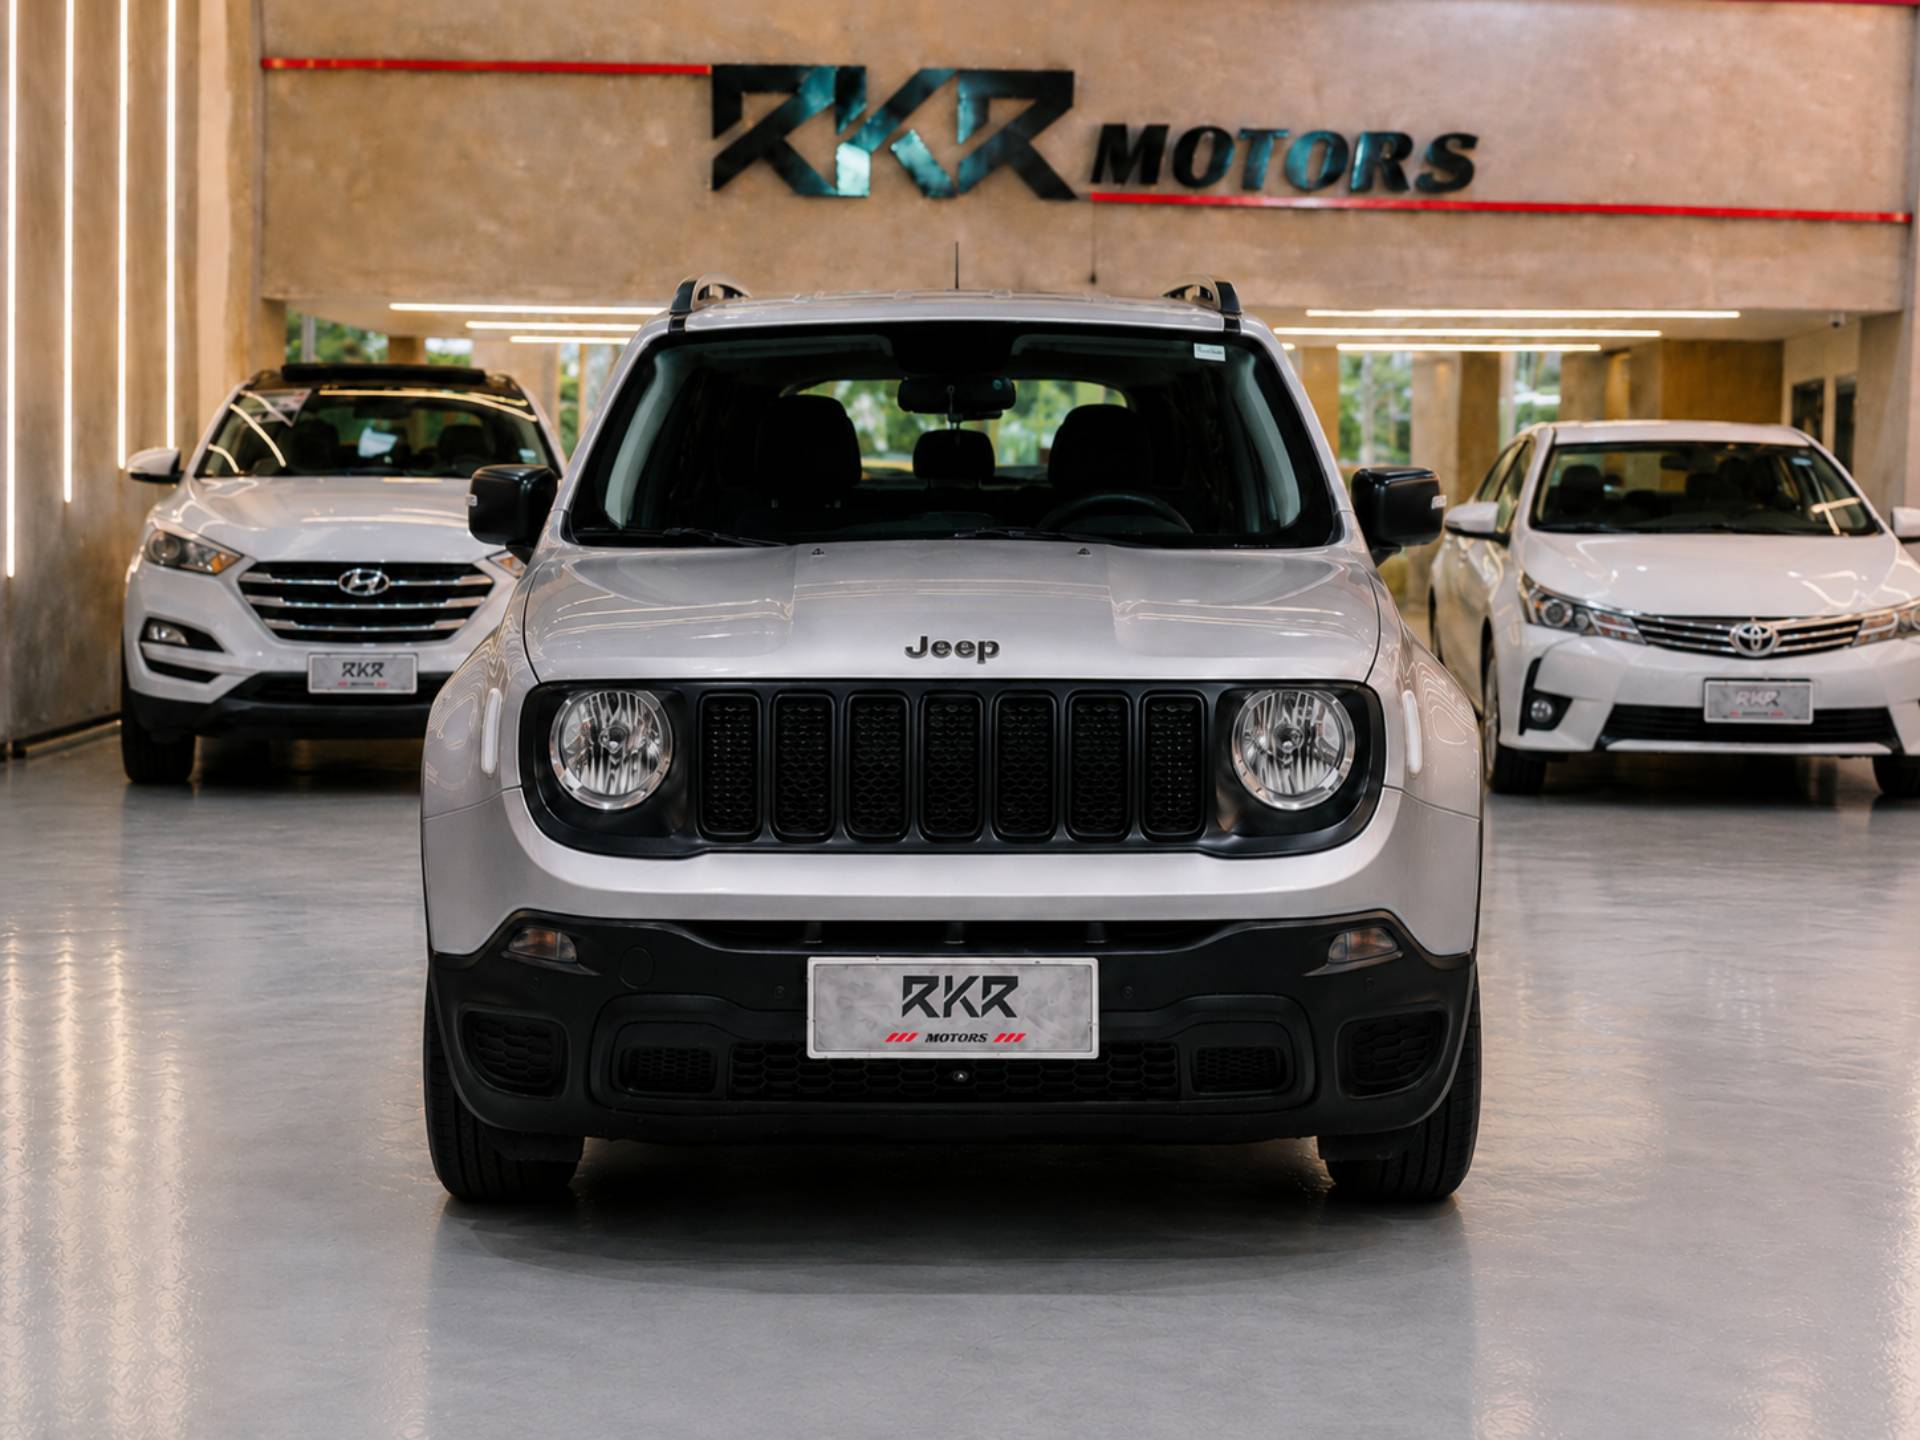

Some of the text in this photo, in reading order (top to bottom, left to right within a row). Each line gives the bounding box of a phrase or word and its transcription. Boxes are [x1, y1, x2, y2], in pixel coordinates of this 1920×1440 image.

[712, 64, 1479, 199] RKR MOTORS
[904, 635, 1000, 664] Jeep
[342, 661, 384, 677] RKR
[902, 975, 1019, 1018] RKR
[925, 1032, 988, 1043] MOTORS
